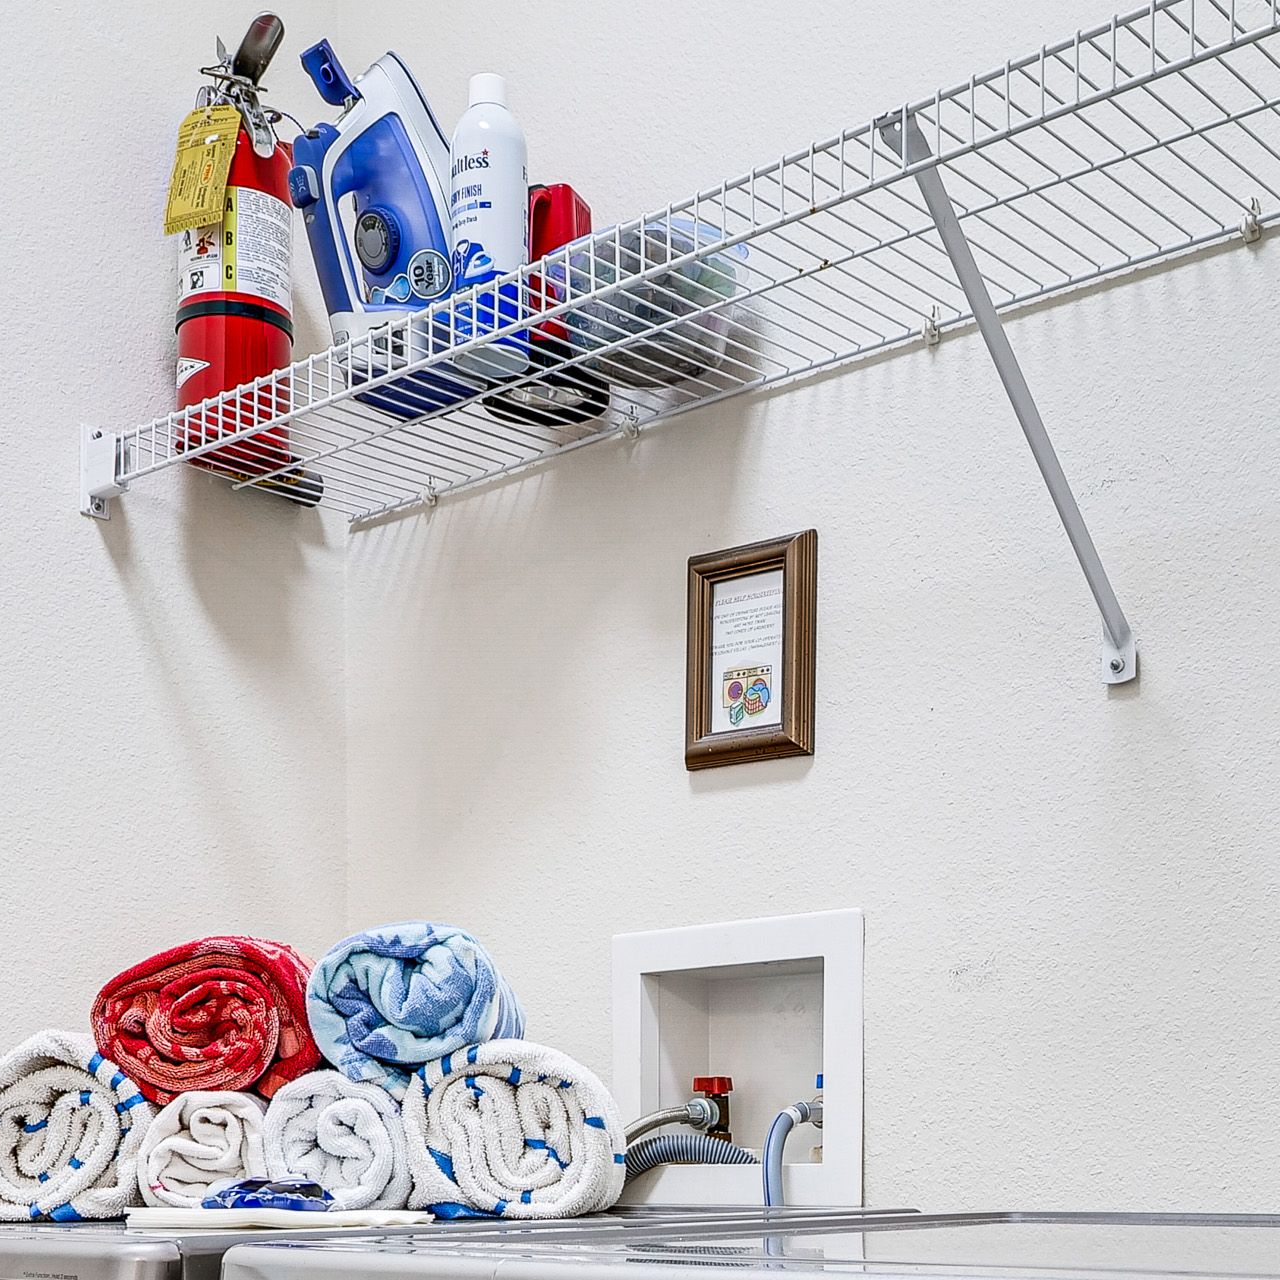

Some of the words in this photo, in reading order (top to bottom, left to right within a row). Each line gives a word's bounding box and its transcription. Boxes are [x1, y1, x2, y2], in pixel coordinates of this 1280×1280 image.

[462, 184, 482, 199] FINISH
[226, 197, 233, 212] A
[226, 231, 233, 245] B
[226, 265, 233, 279] C
[413, 265, 424, 286] 10
[425, 259, 434, 290] Year
